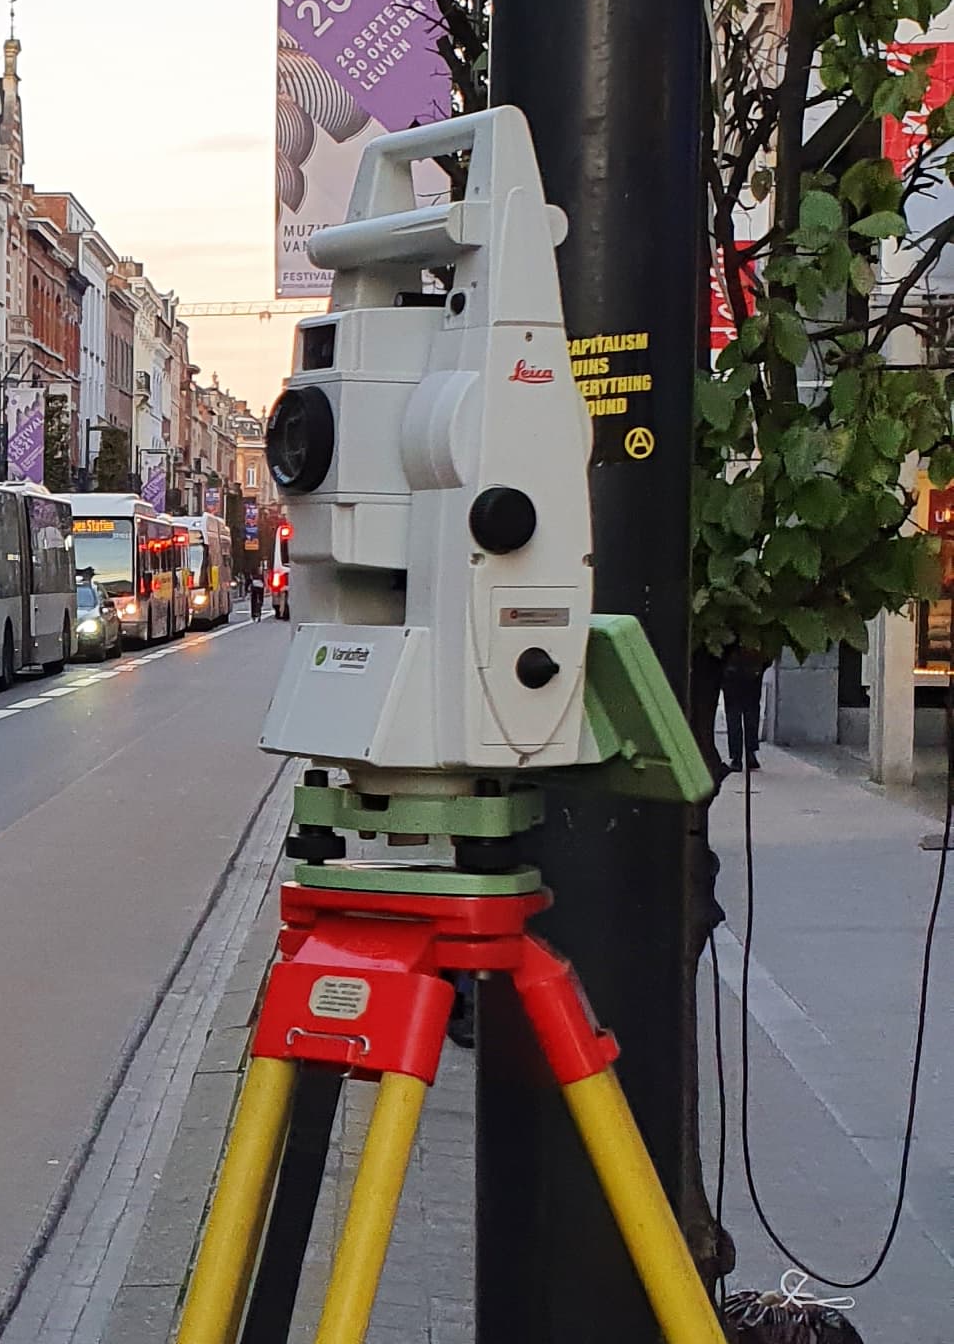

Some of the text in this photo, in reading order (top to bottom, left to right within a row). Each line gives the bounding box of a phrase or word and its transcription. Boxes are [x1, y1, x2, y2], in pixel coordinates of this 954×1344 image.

[348, 0, 427, 79] 30 OKTOBER
[336, 47, 356, 68] 26
[360, 39, 412, 91] LEUVEN
[283, 272, 333, 281] FESTIVAL
[509, 360, 555, 384] Leica
[572, 358, 610, 377] UINS
[577, 375, 652, 397] VERYTHING
